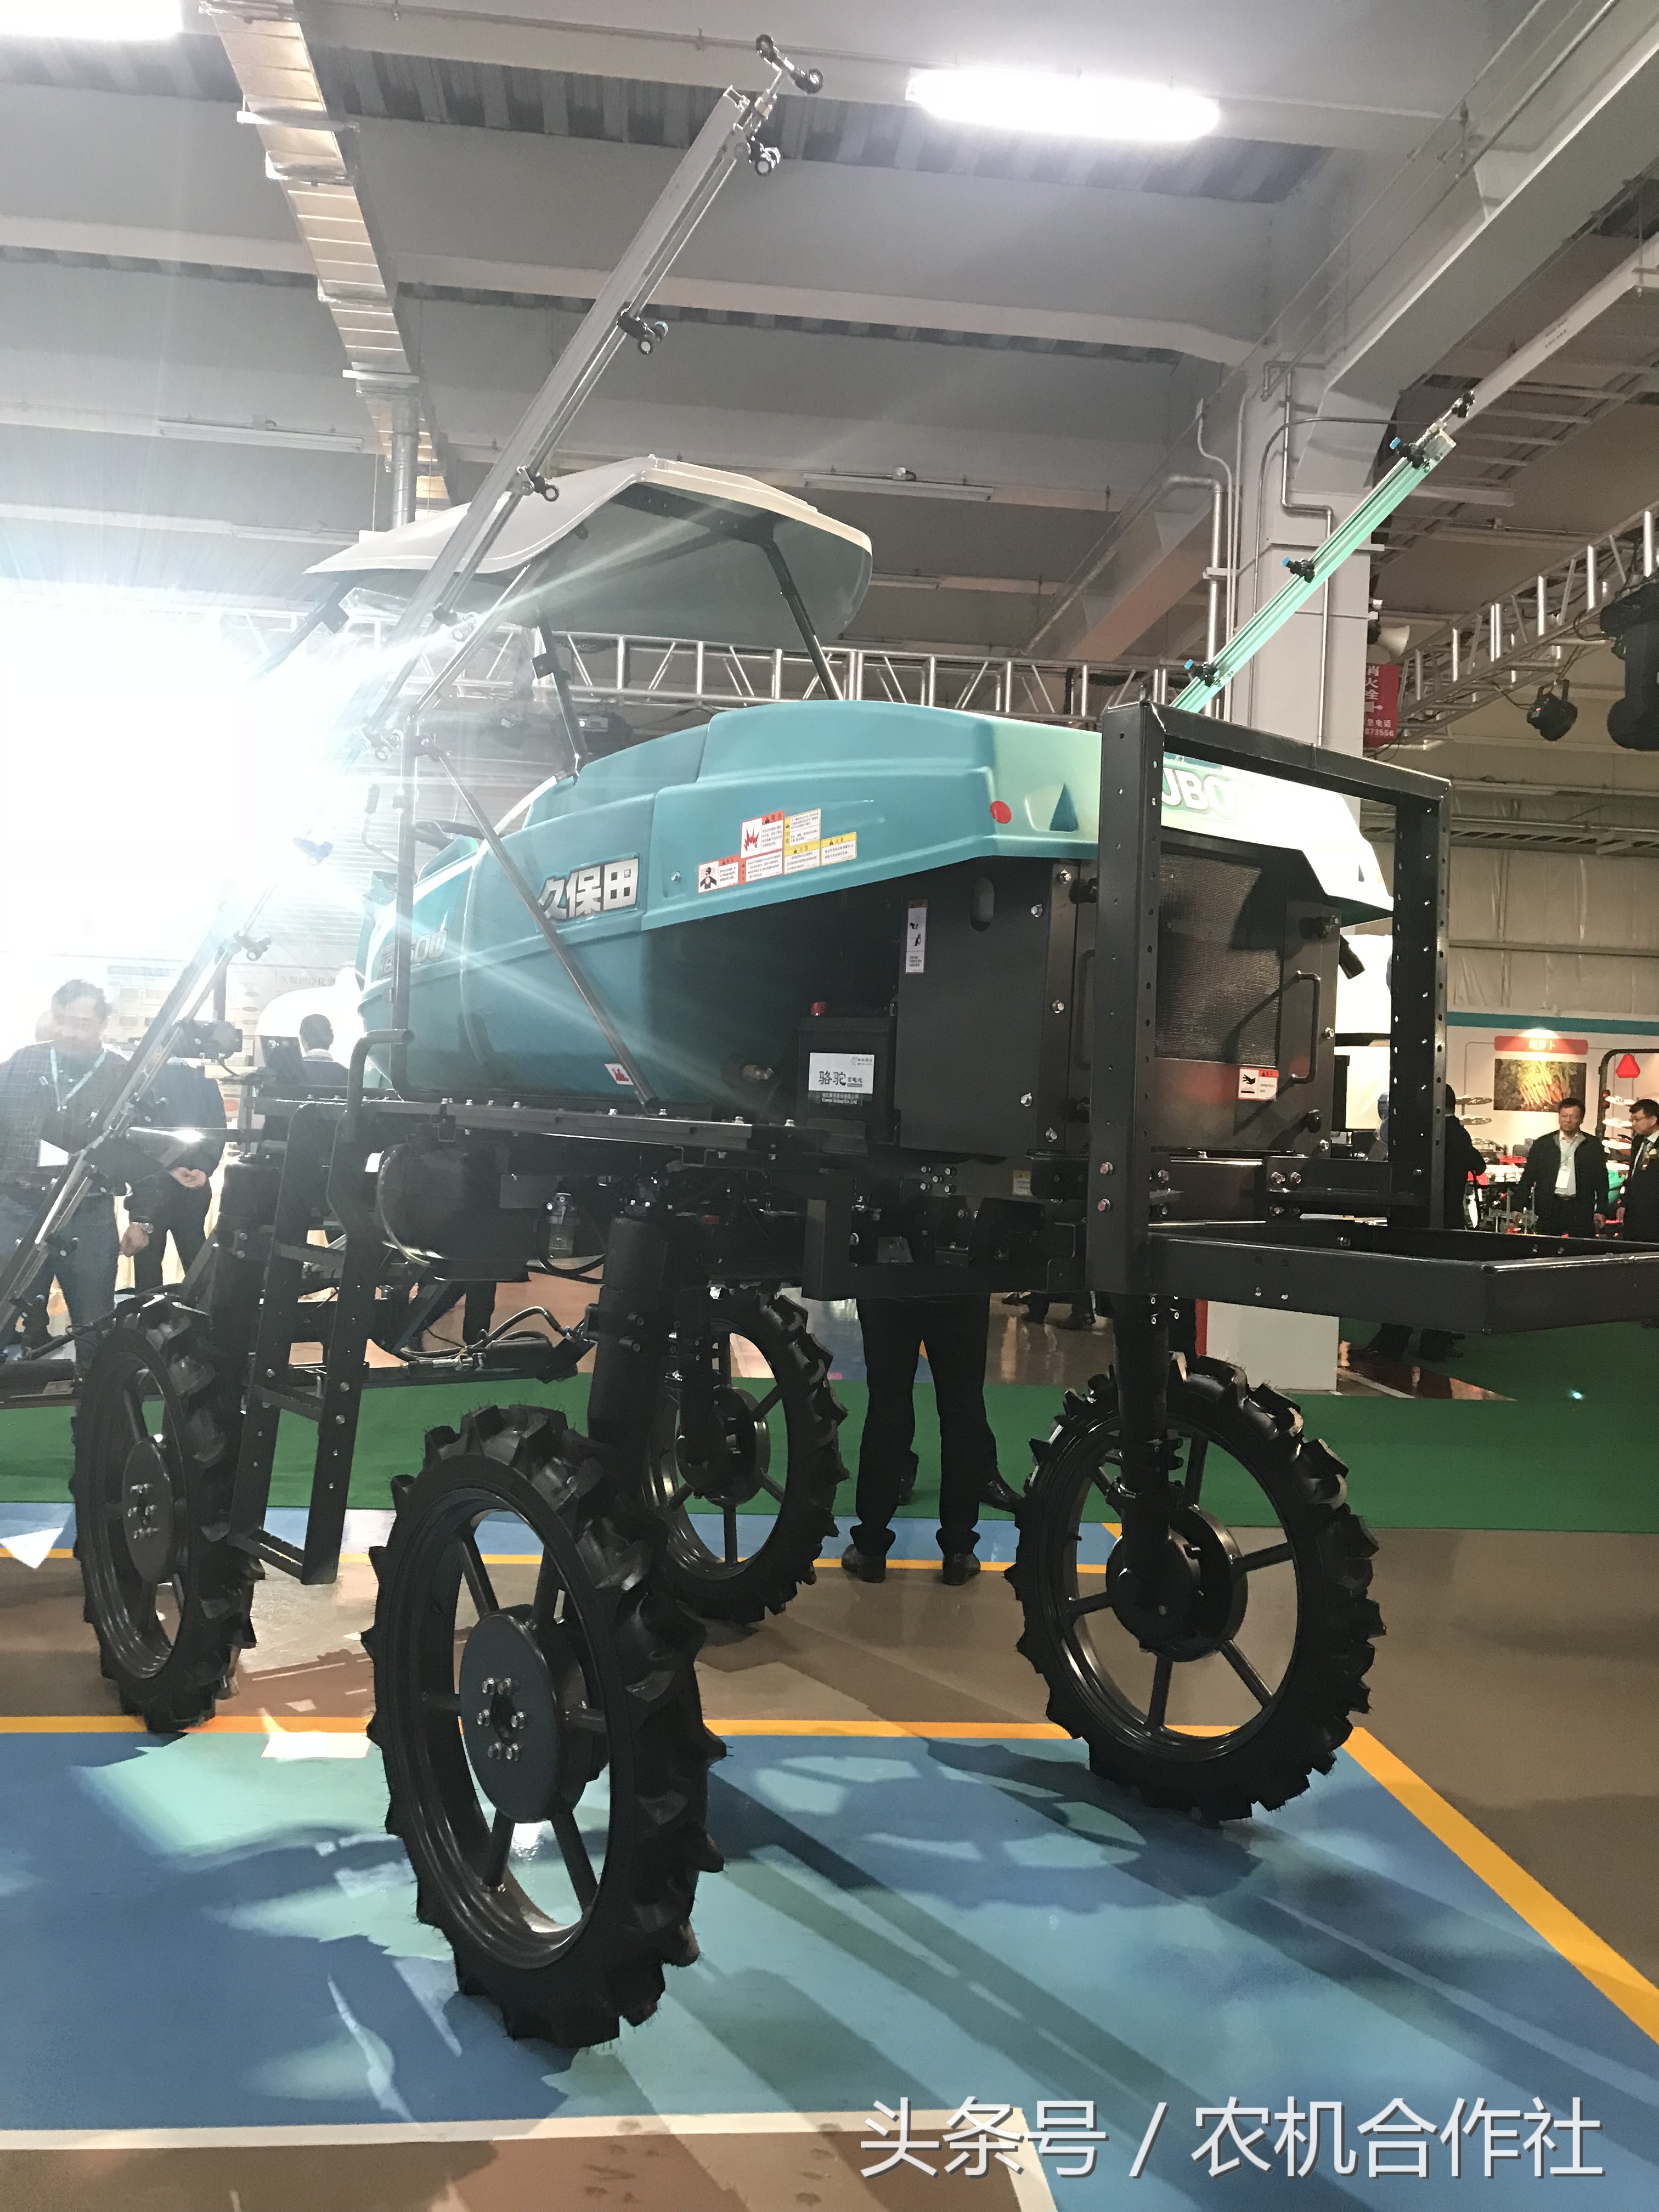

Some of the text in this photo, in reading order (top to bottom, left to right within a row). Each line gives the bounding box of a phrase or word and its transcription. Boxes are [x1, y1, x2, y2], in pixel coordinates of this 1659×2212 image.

[1364, 718, 1392, 728] 急电话
[538, 858, 639, 921] 久保田
[818, 1070, 847, 1086] 骆驼
